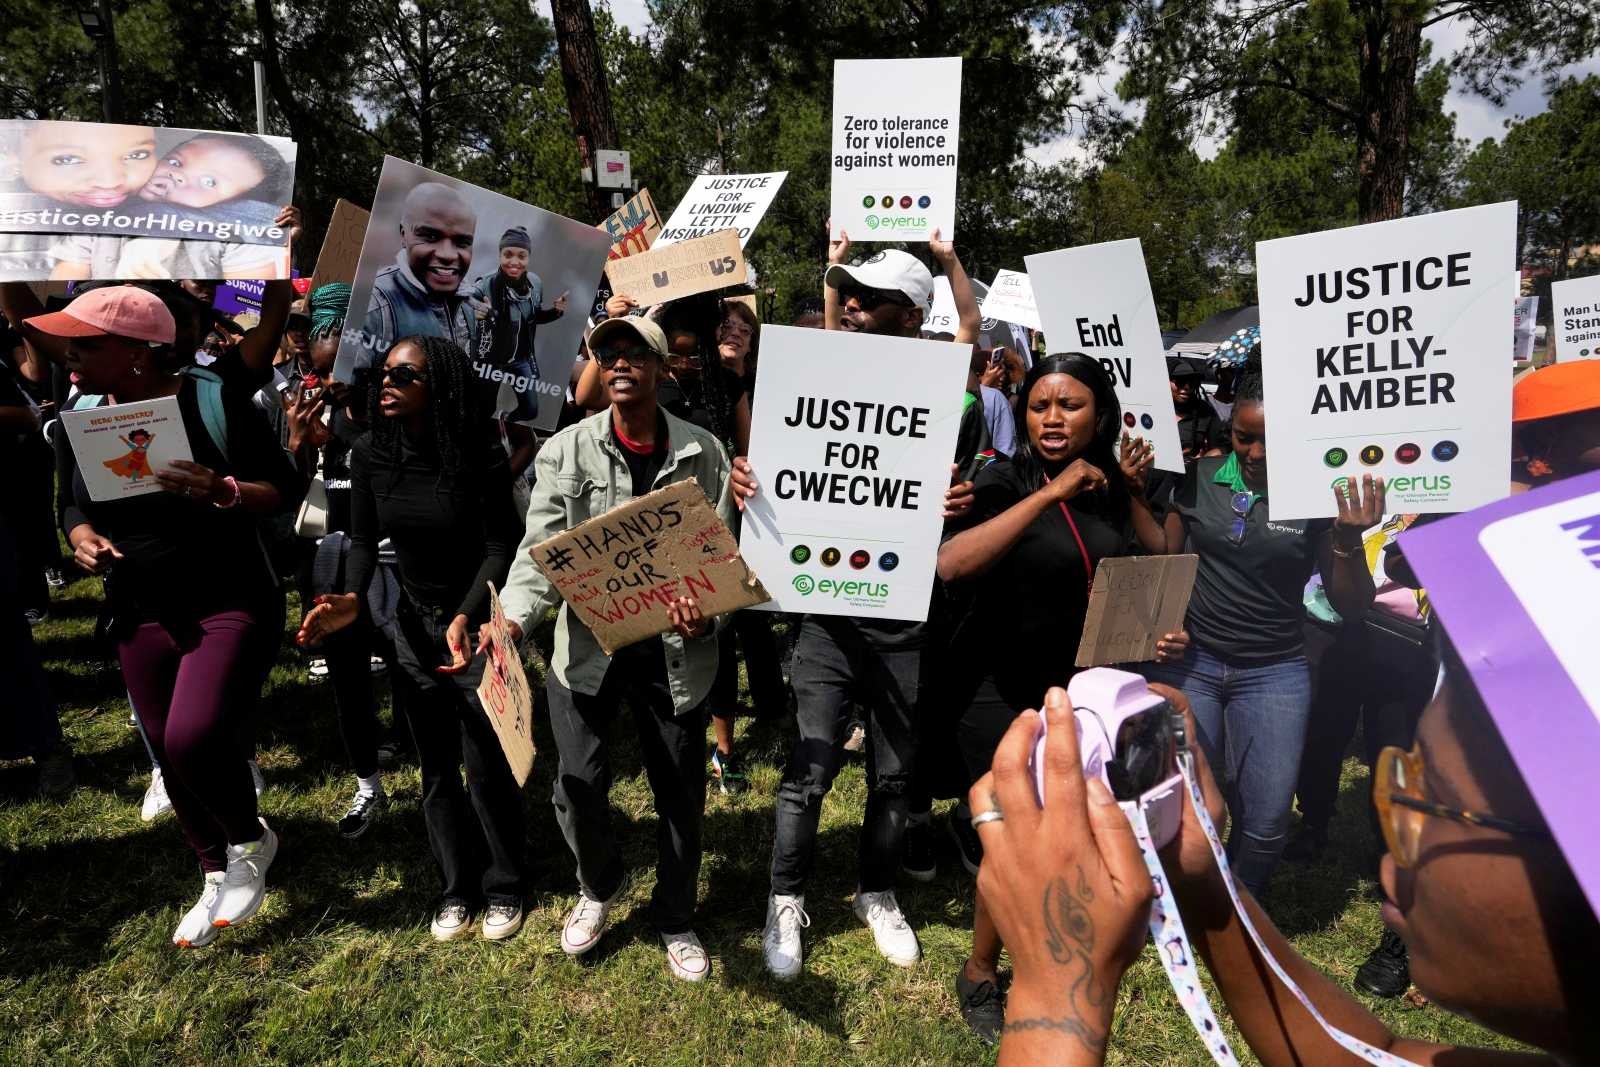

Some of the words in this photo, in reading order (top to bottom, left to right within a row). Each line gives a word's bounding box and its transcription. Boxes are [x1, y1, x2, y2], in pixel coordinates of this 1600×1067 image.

[844, 115, 878, 131] Zero
[883, 116, 949, 130] tolerance
[846, 132, 869, 149] for
[875, 132, 946, 149] violence
[834, 152, 893, 171] against
[898, 153, 956, 168] women
[704, 176, 772, 190] JUSTICE
[715, 192, 743, 202] FOR
[689, 202, 756, 215] LINDIWE
[690, 215, 737, 227] LETTI
[881, 215, 927, 229] eyerus
[660, 227, 751, 240] MSIMO
[1294, 252, 1471, 307] JUSTICE
[1347, 305, 1413, 337] FOR
[1564, 304, 1590, 317] Man
[1076, 314, 1124, 348] End
[1316, 336, 1447, 378] KELLY-
[1311, 372, 1456, 414] AMBER
[784, 397, 930, 438] JUSTICE
[824, 441, 879, 470] FOR
[775, 469, 921, 510] CWECWE
[1366, 474, 1452, 495] yerus
[615, 538, 660, 570] OFF
[606, 562, 668, 593] OUR
[586, 569, 716, 624] WOMEN
[818, 579, 889, 598] eyerus
